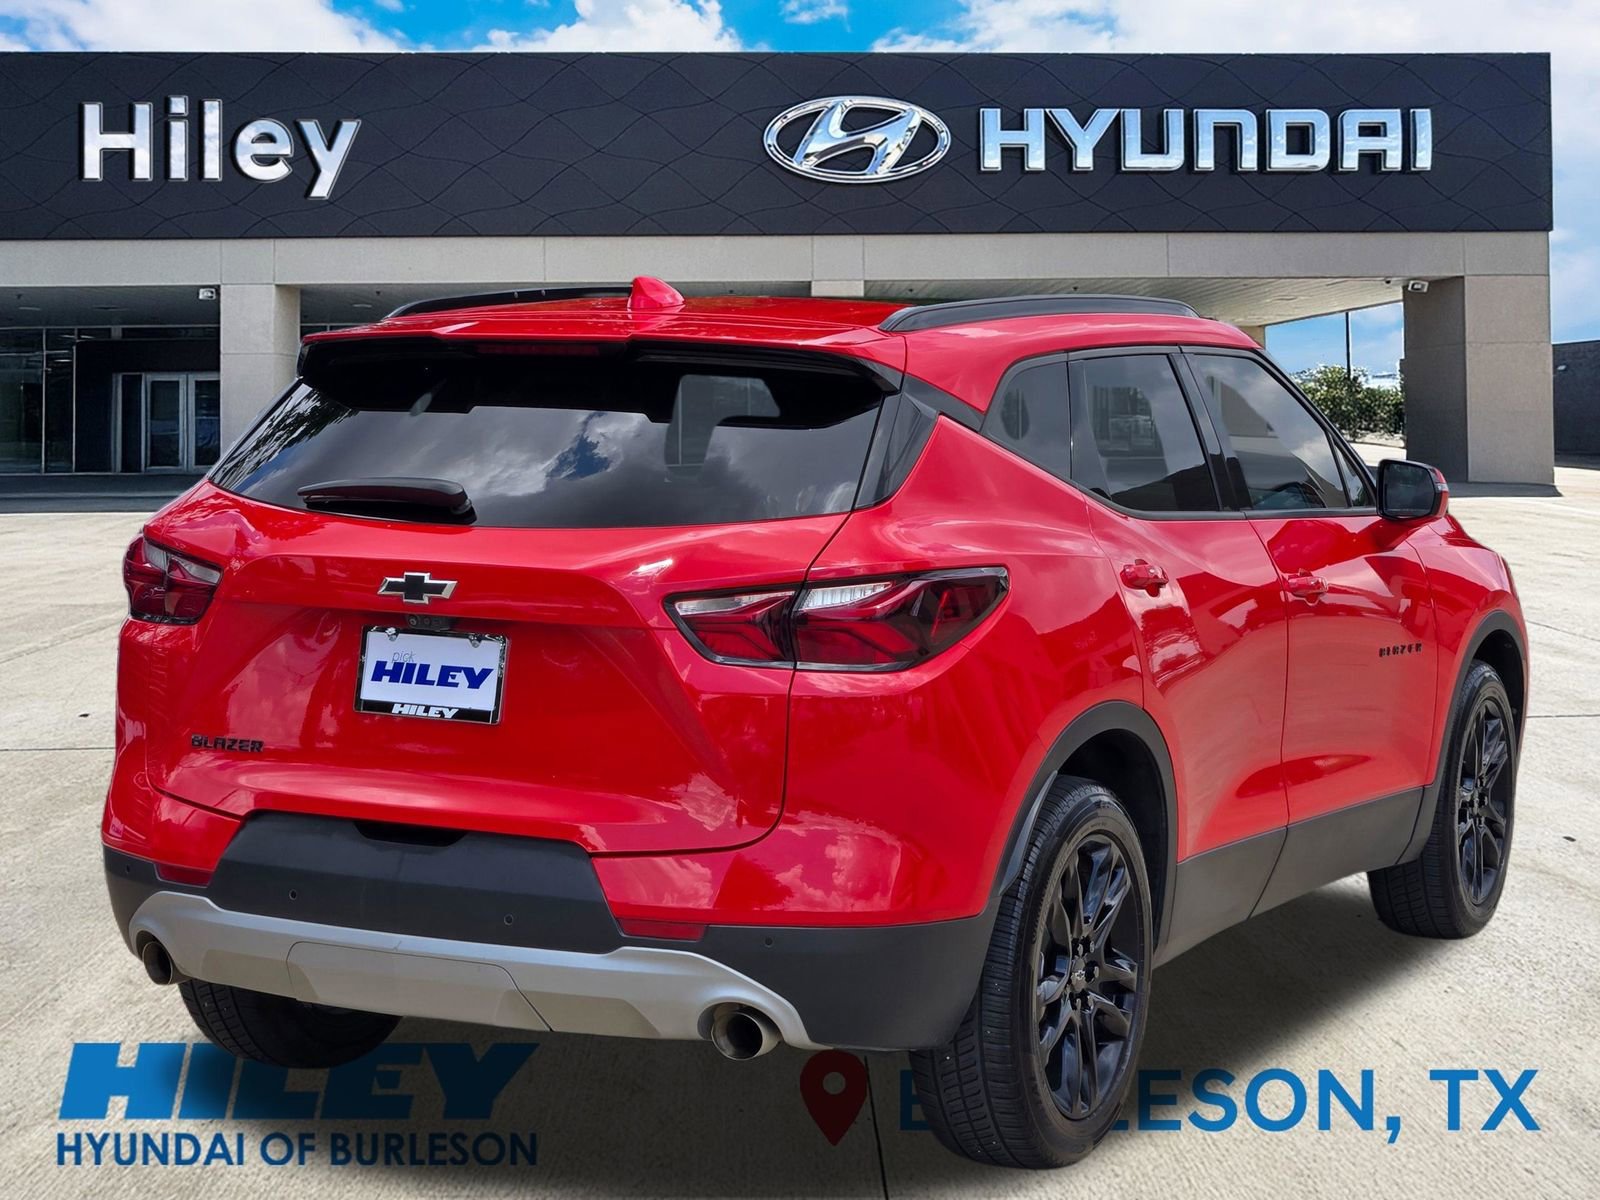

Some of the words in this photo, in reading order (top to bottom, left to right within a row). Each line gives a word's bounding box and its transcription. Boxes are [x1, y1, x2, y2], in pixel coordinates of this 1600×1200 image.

[79, 95, 361, 199] Hiley
[979, 107, 1433, 172] HYUNDAI
[391, 650, 416, 664] pick
[371, 660, 493, 689] HILEY
[391, 703, 459, 718] HILEY
[190, 733, 264, 753] BLAZER
